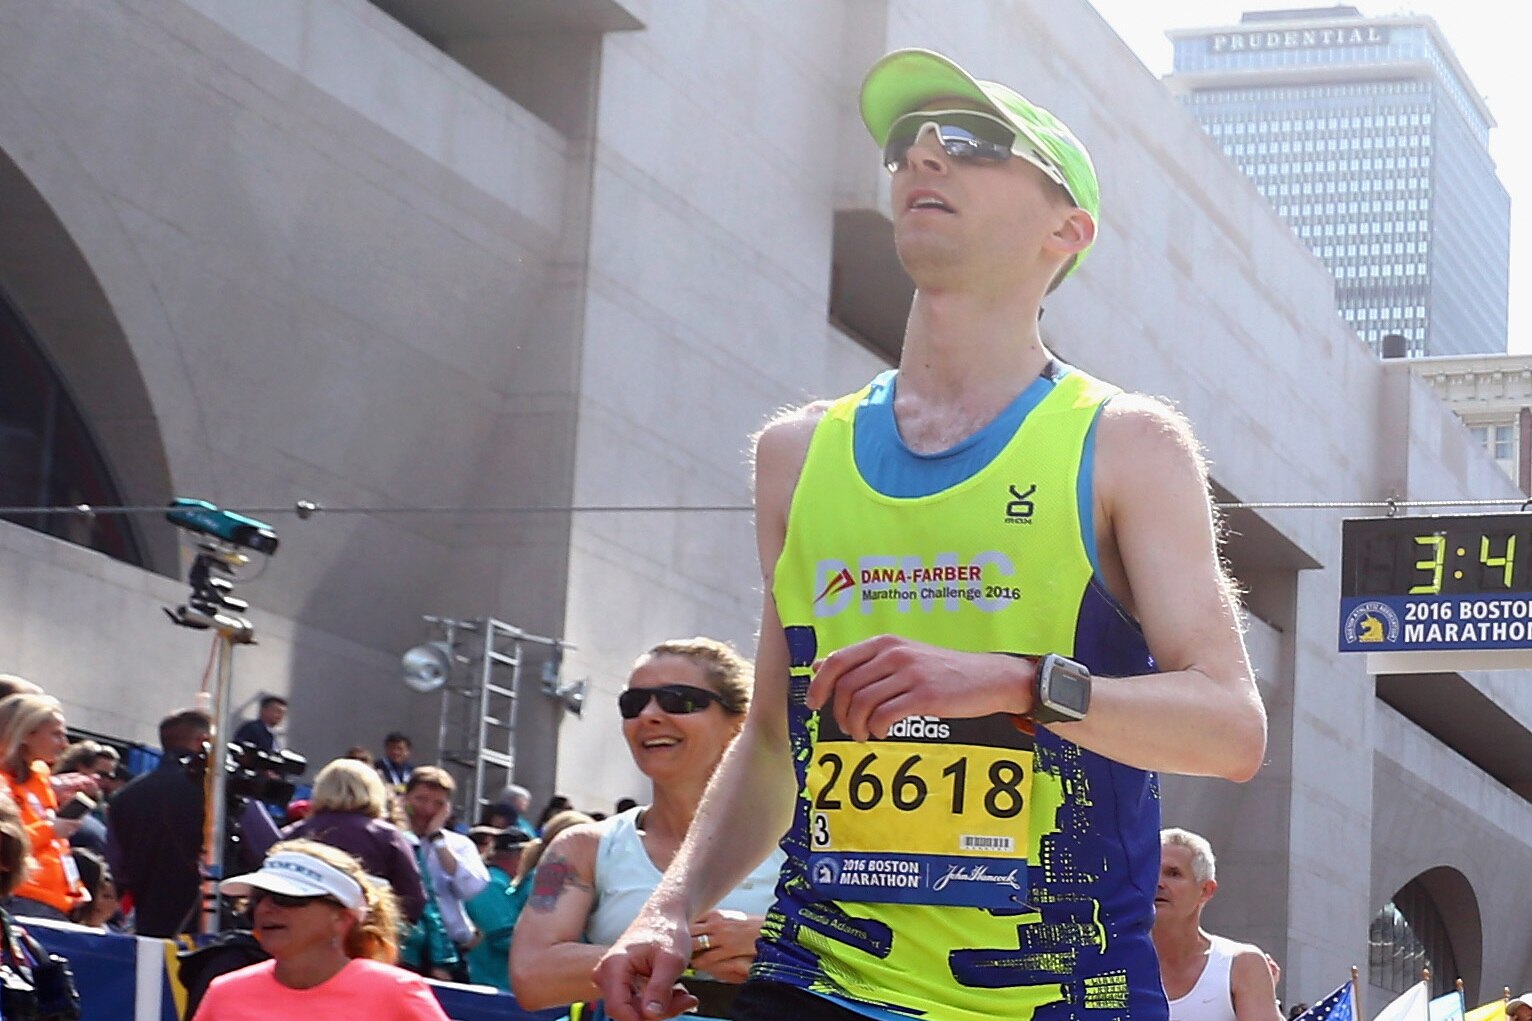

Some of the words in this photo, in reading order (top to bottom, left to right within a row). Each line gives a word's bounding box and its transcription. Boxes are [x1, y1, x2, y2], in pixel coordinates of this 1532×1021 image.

[1214, 27, 1381, 50] PRUDENTIAL
[861, 565, 982, 585] DANA-FARBER
[862, 587, 918, 601] Marathon
[920, 586, 983, 601] Challenge
[985, 585, 1022, 601] 2016
[1404, 603, 1452, 622] 2016
[815, 752, 1025, 819] 26618
[814, 814, 830, 847] 3
[842, 858, 866, 872] 2016
[868, 859, 920, 874] BOSTON
[839, 872, 920, 889] MARATHON
